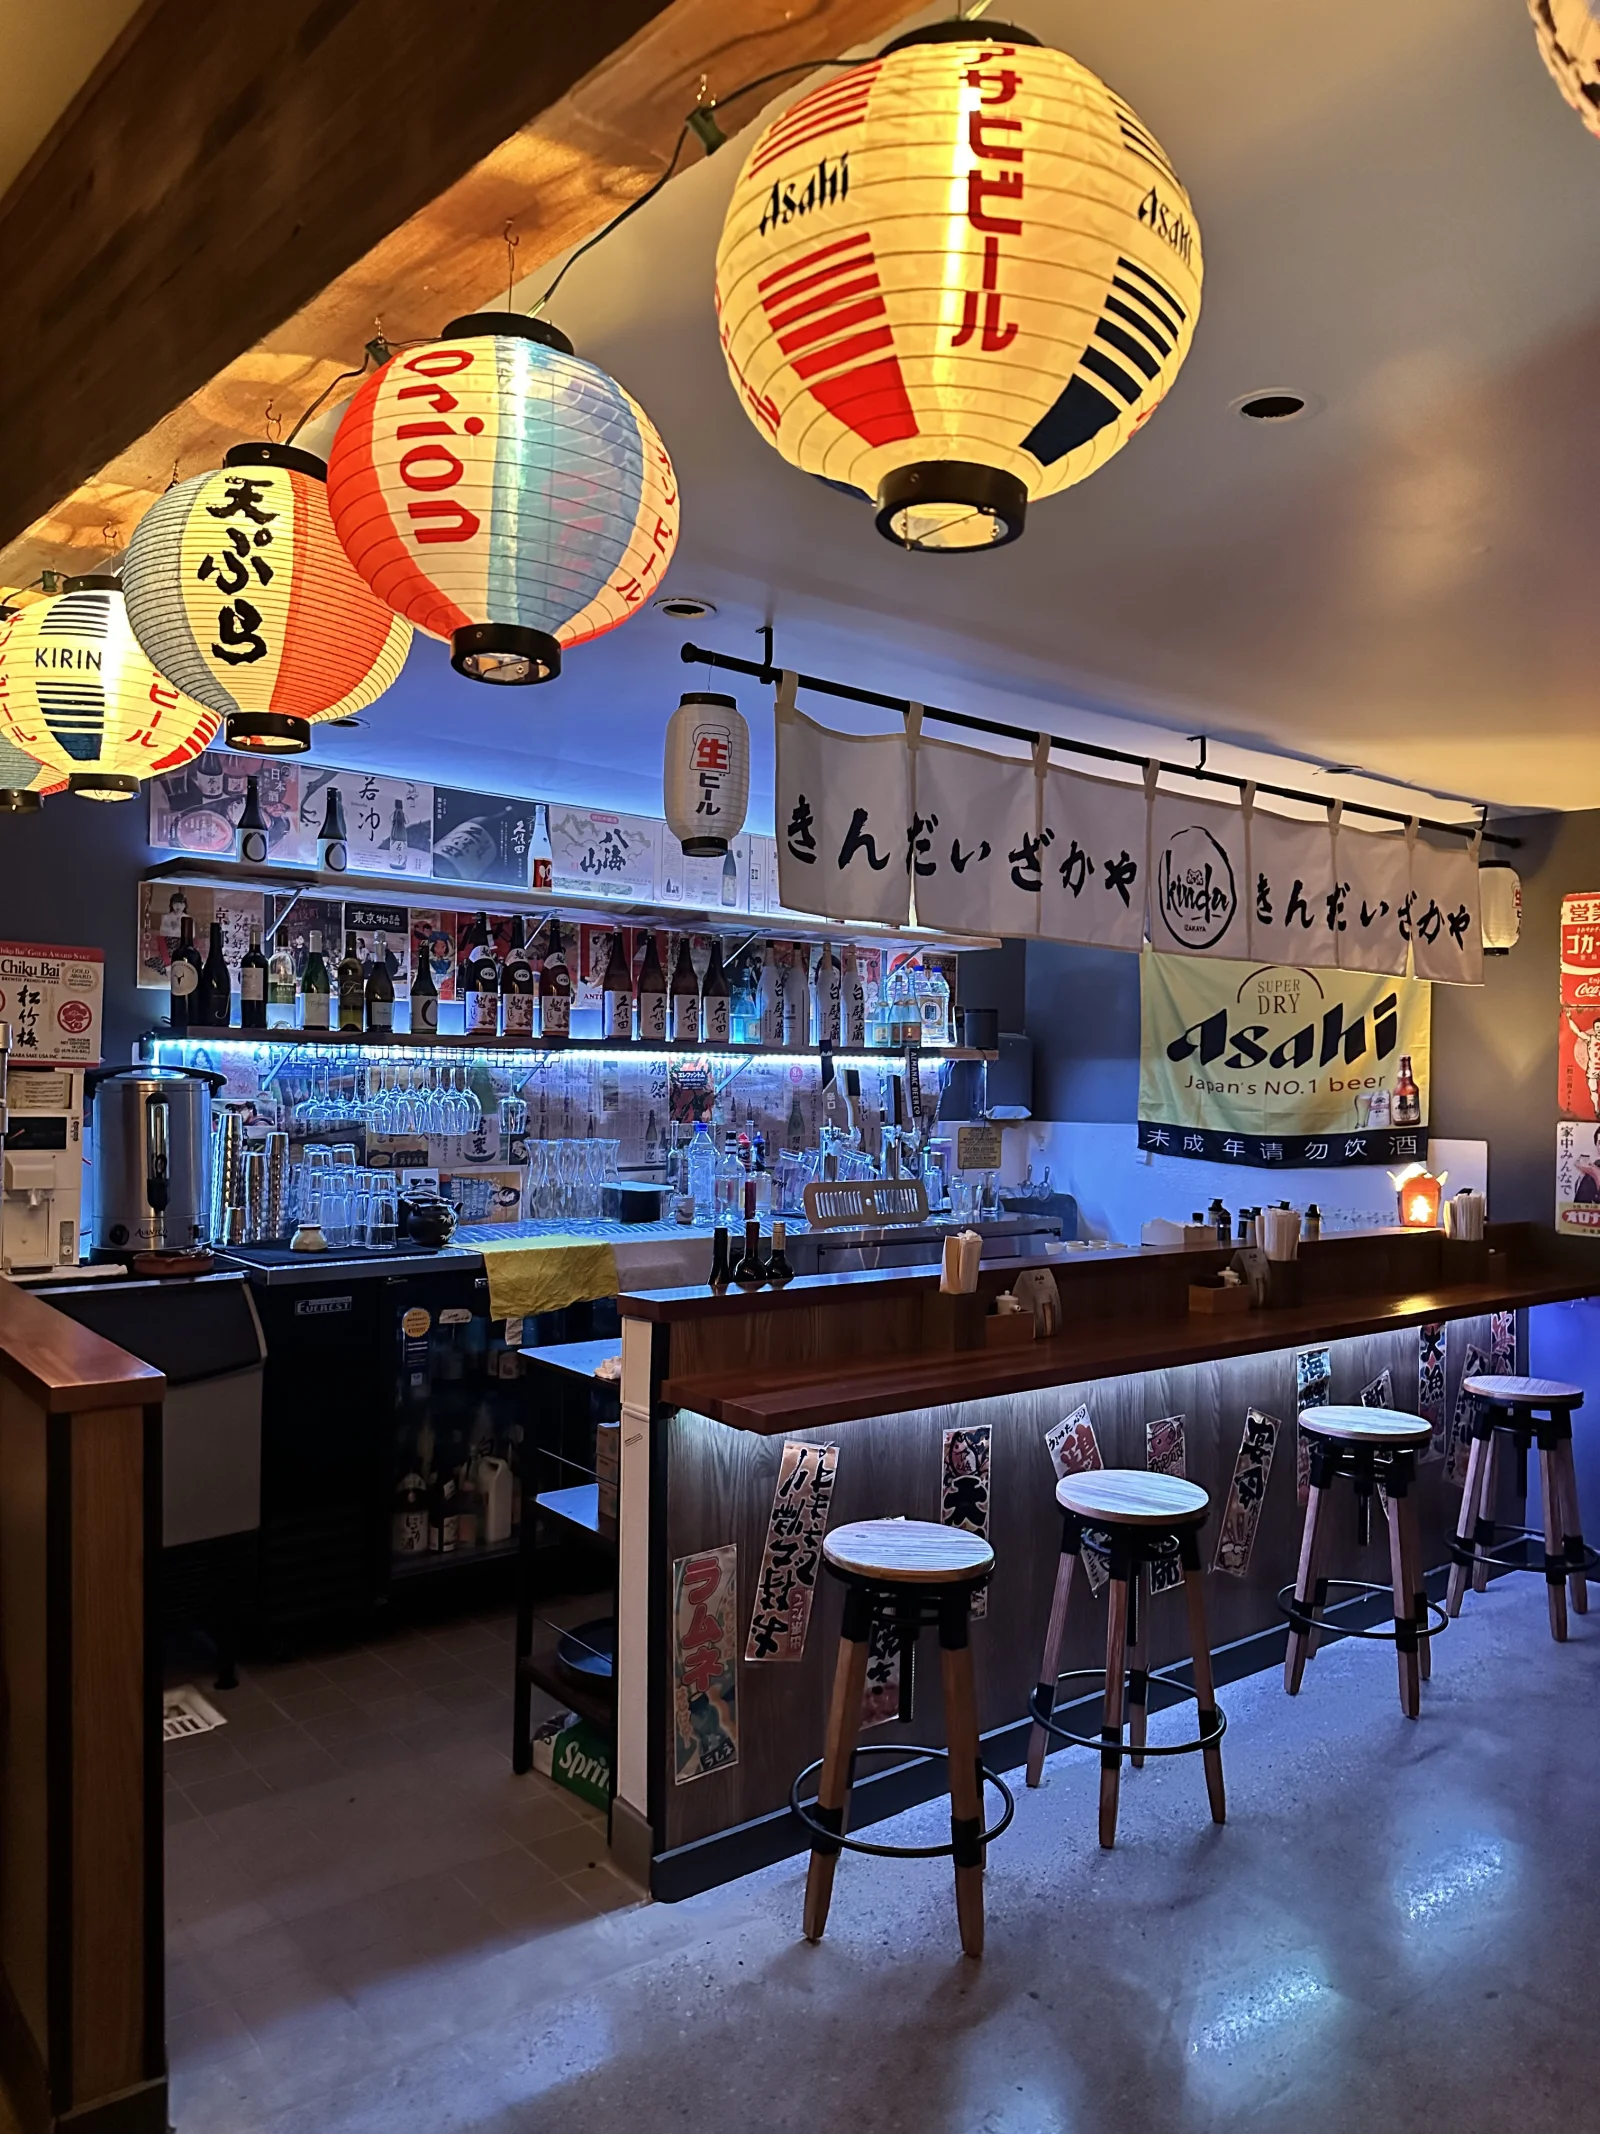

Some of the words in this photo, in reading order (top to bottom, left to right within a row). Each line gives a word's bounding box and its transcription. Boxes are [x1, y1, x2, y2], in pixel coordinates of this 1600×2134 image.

[758, 151, 850, 236] Asahi
[1139, 186, 1193, 267] Asahi
[198, 477, 281, 665] 天ぷら
[35, 647, 102, 671] KIRIN
[268, 768, 286, 802] 日本酒
[695, 736, 728, 816] 生ビール
[580, 828, 629, 876] 八海山
[787, 794, 1138, 908] きんだいざかや
[1165, 849, 1230, 924] kinda
[1256, 872, 1471, 951] きんだいざかや
[1, 959, 38, 977] Chiku
[40, 961, 60, 977] Bai
[1257, 978, 1301, 995] SUPER
[17, 984, 40, 1048] 松竹梅
[1166, 992, 1398, 1070] Asahi
[1257, 993, 1301, 1016] DRY
[910, 1051, 918, 1087] ALMANAC
[911, 1087, 920, 1105] BEER
[1184, 1074, 1257, 1096] Japan's
[1264, 1077, 1318, 1096] NO.1
[1328, 1074, 1387, 1093] beer
[1147, 1128, 1418, 1161] 未成年请勿饮酒
[1560, 1125, 1574, 1196] 家中みんなで
[470, 1179, 478, 1216] FASHION
[750, 1448, 808, 1659] お持ち帰り
[681, 1556, 724, 1692] ラムネ
